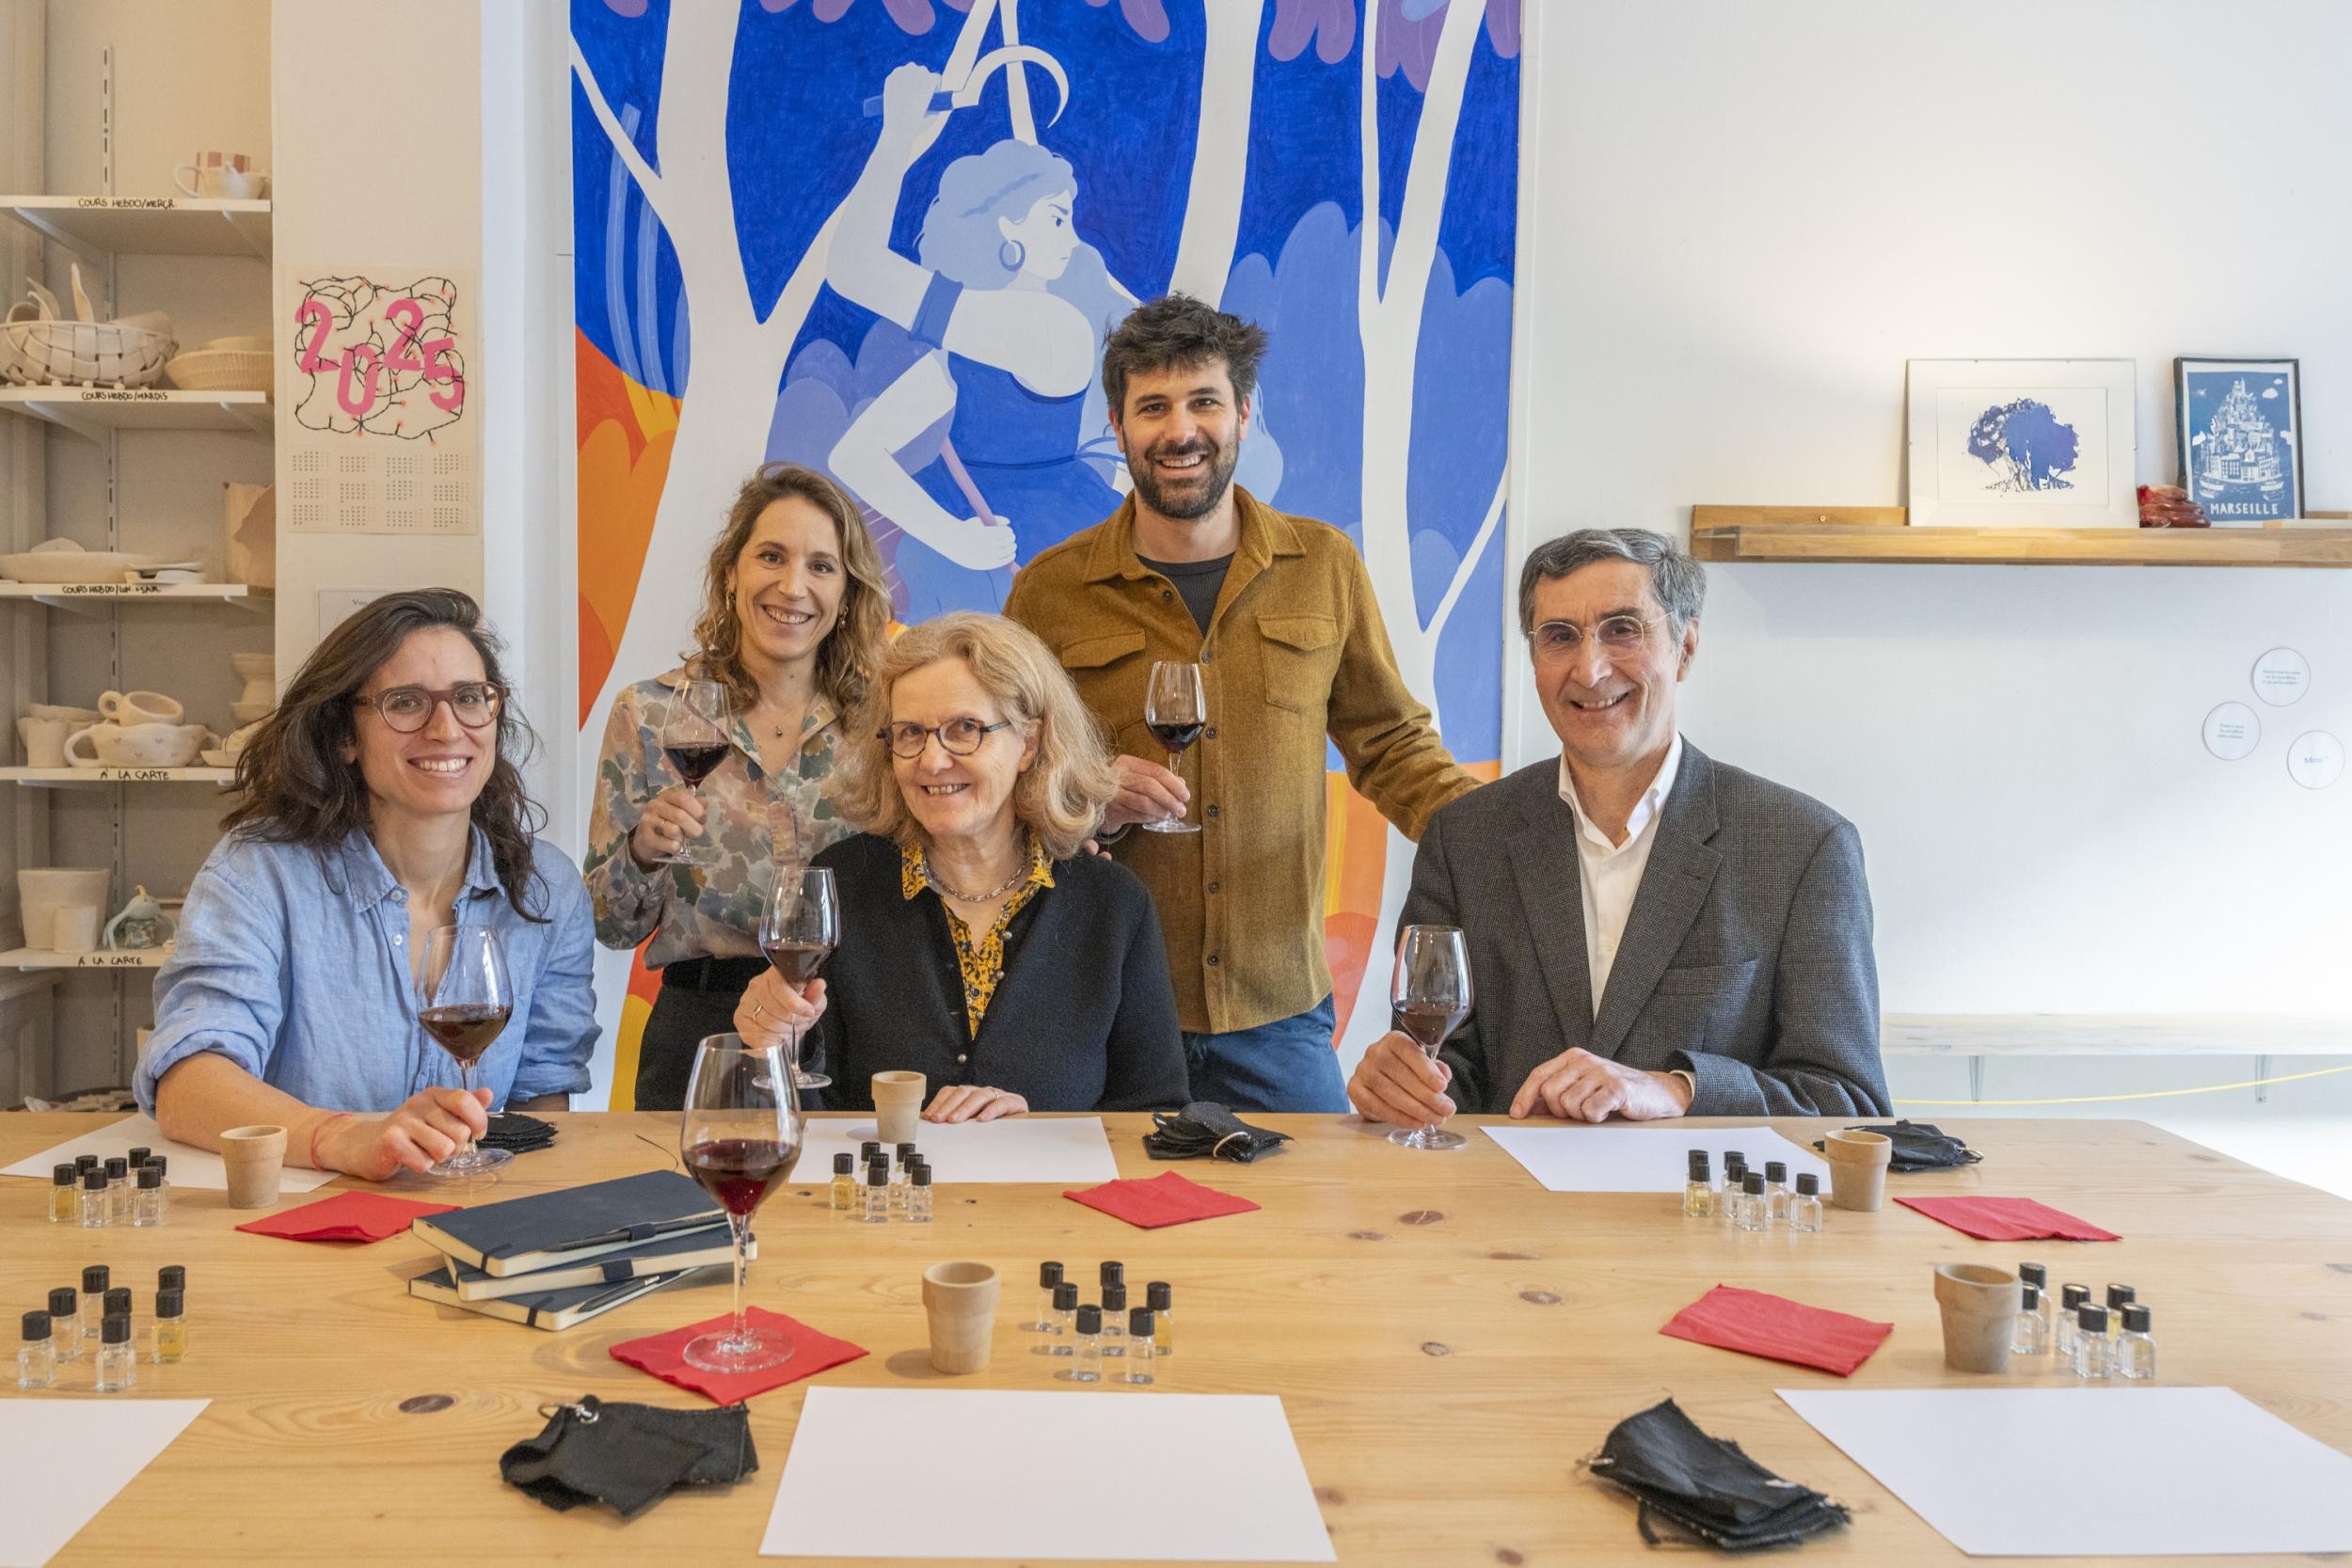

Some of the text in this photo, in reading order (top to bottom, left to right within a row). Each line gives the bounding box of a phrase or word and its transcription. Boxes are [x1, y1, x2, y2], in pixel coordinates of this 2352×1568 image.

[78, 198, 107, 207] COURS
[294, 298, 465, 415] 2025
[81, 391, 106, 401] COURS
[2211, 503, 2279, 515] MARSEILLE
[62, 585, 87, 594] COURS
[118, 770, 131, 780] LA
[135, 770, 170, 780] CARTE
[93, 957, 104, 965] LA
[111, 956, 143, 965] CARTE
